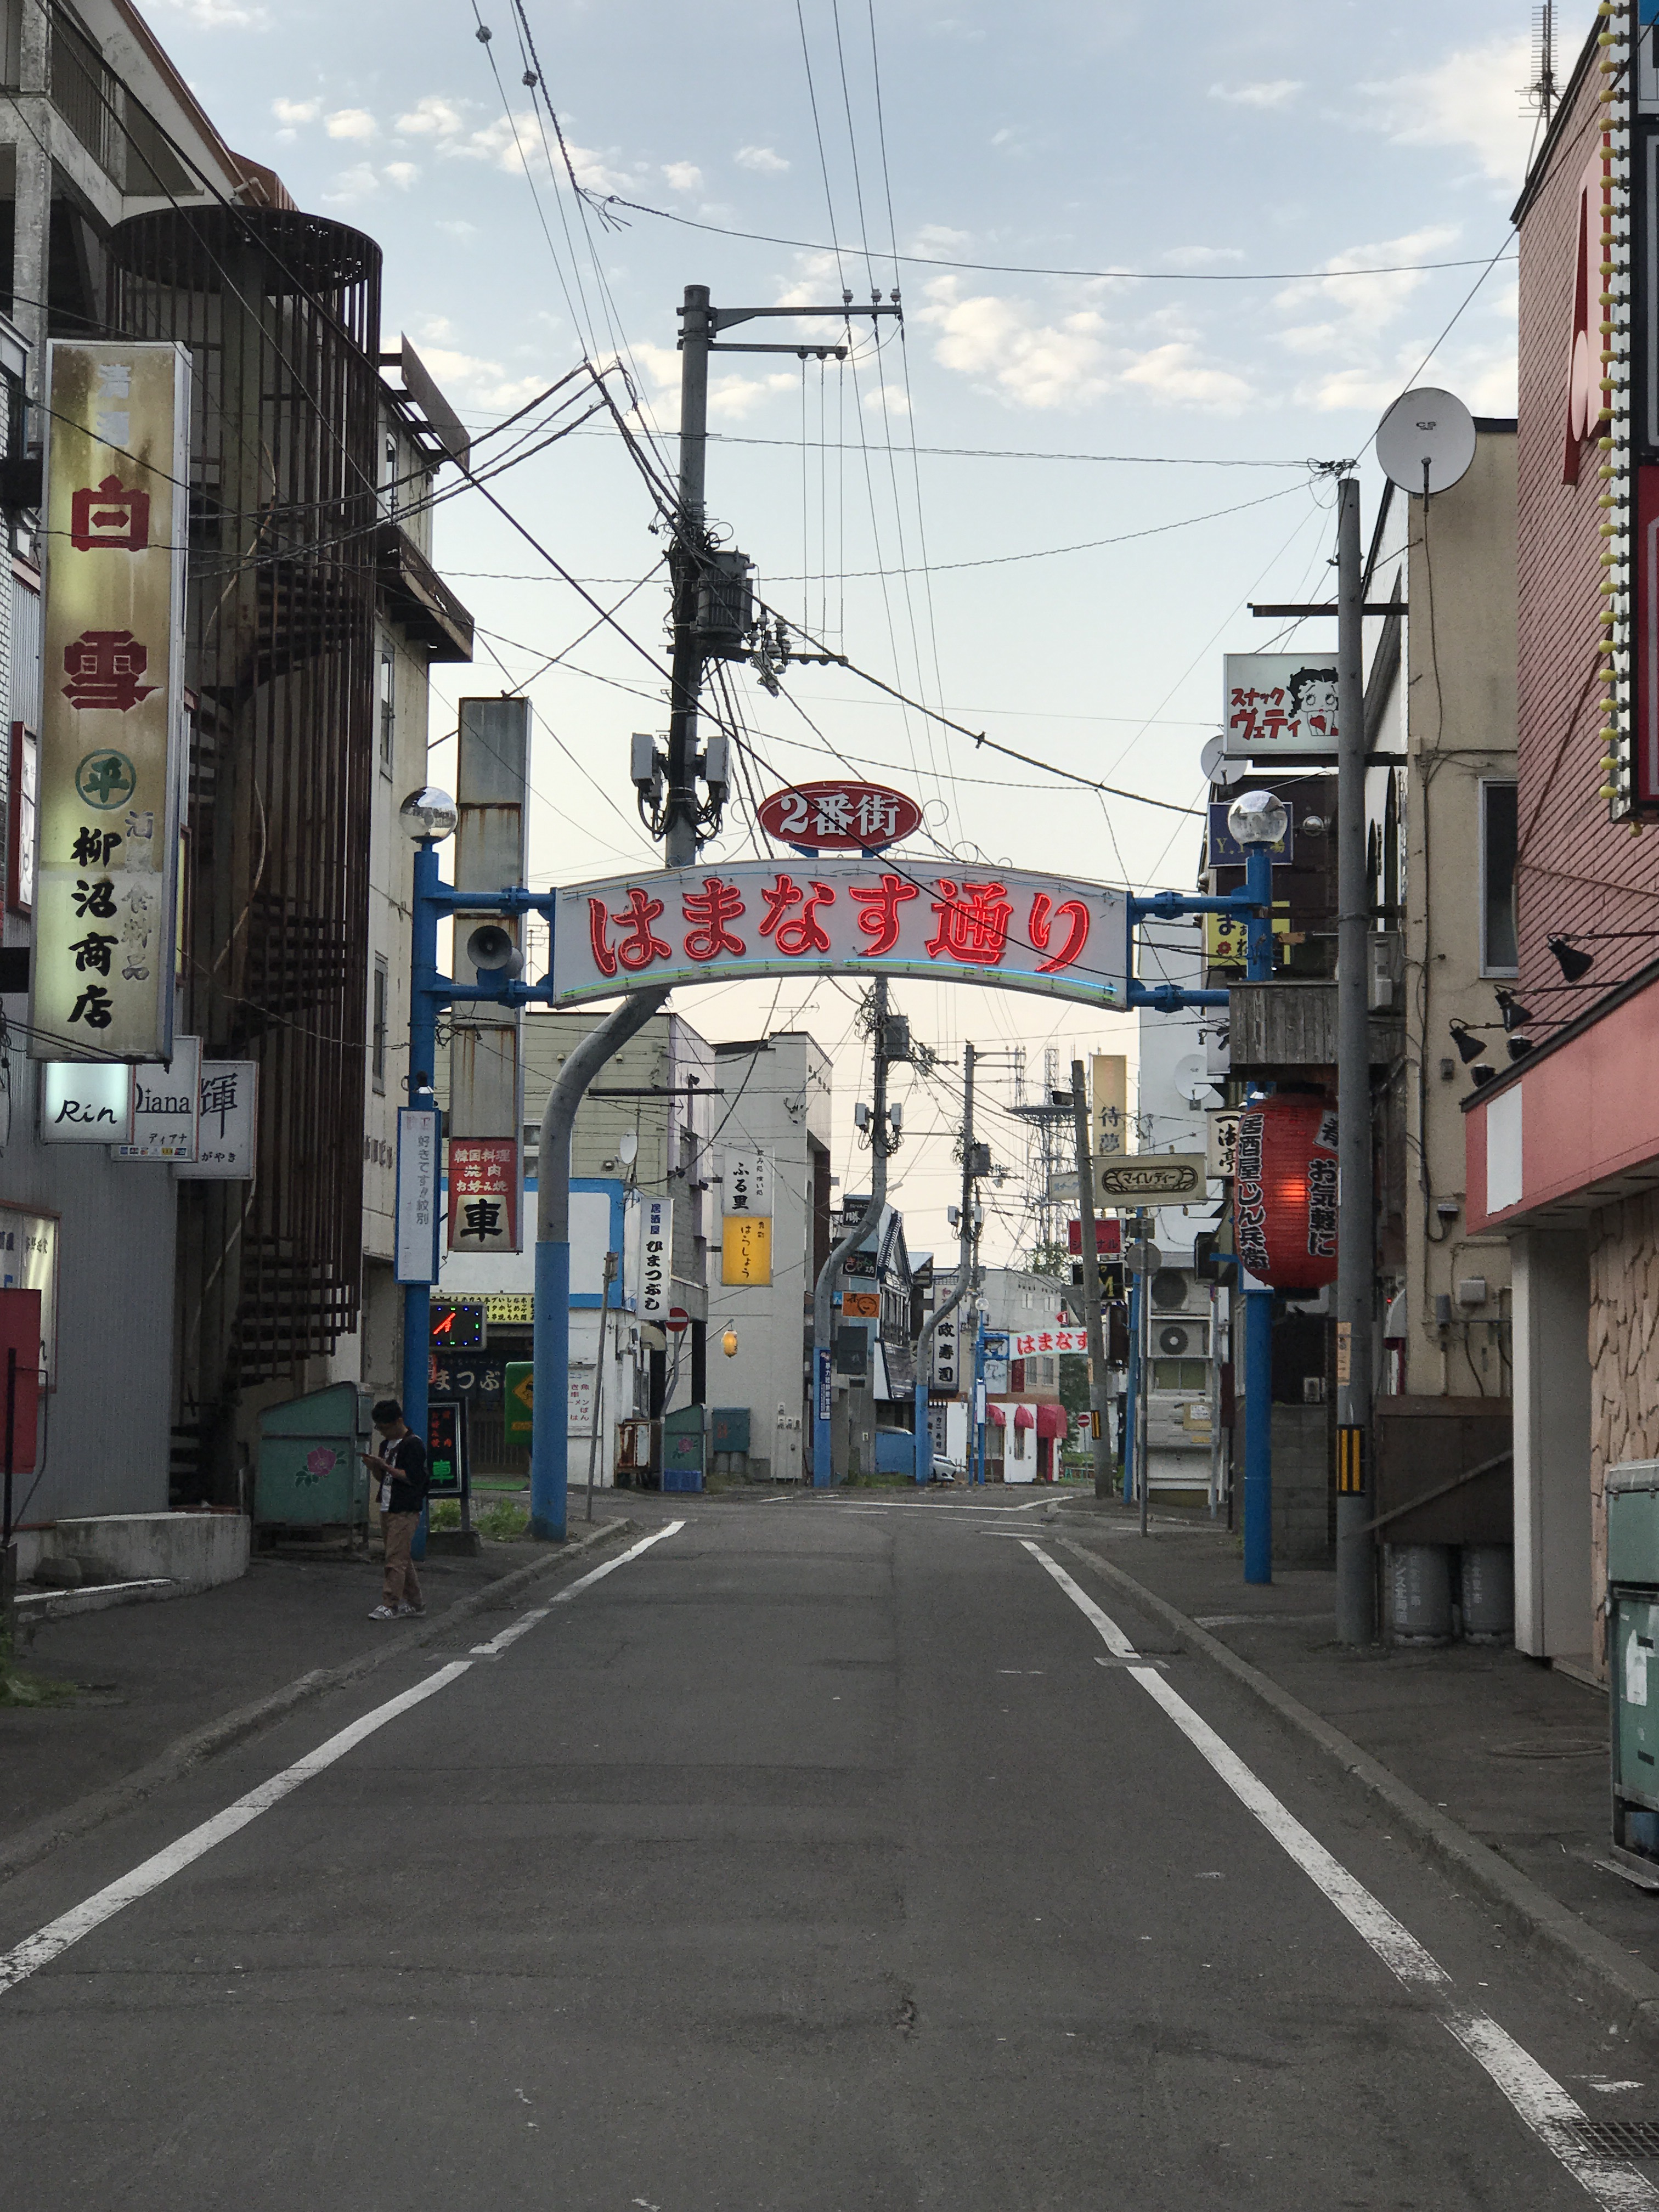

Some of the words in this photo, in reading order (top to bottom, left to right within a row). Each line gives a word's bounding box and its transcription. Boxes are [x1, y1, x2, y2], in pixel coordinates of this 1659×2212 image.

[1231, 687, 1285, 707] スナック
[1230, 707, 1301, 740] ヴェティ
[778, 793, 901, 838] 2番街
[68, 826, 122, 1029] 柳沼商店
[589, 874, 1090, 977] はまなす通り
[54, 1099, 117, 1125] Rin
[149, 1133, 188, 1144] ディアナ
[454, 1148, 510, 1164] 韓国料理
[464, 1164, 501, 1177] 焼肉
[732, 1162, 749, 1210] ふる里
[1122, 1172, 1176, 1184] マイレディー
[460, 1198, 503, 1243] 車
[650, 1204, 661, 1234] 居酒屋
[644, 1240, 663, 1311] ひまつぶし
